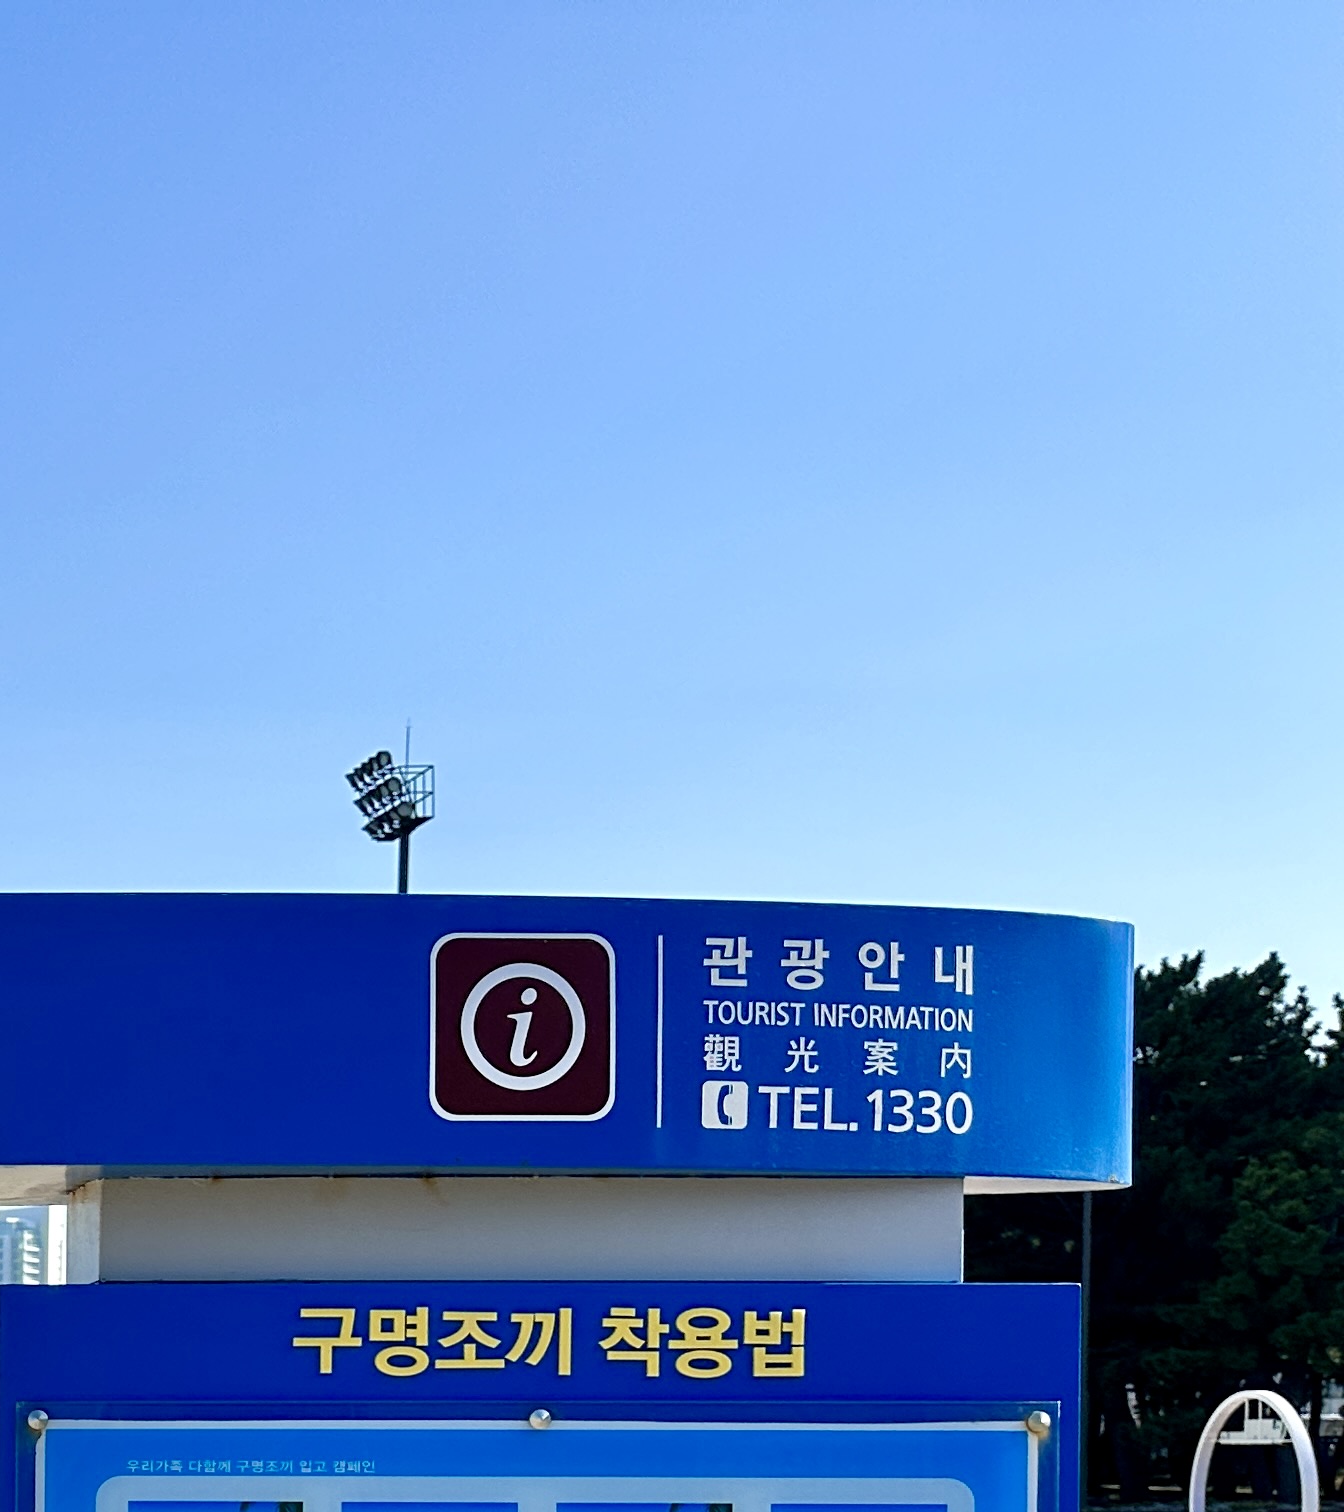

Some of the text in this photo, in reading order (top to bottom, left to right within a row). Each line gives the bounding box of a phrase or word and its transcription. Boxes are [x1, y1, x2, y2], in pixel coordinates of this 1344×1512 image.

[703, 936, 974, 995] 관광안내
[703, 1000, 974, 1032] TOURIST INFORMATION
[292, 1307, 807, 1379] 구명조끼 착용법
[126, 1460, 183, 1473] 우리가족
[189, 1460, 231, 1473] 다함께
[237, 1460, 293, 1473] 구명조끼
[333, 1460, 375, 1473] 캠페인
